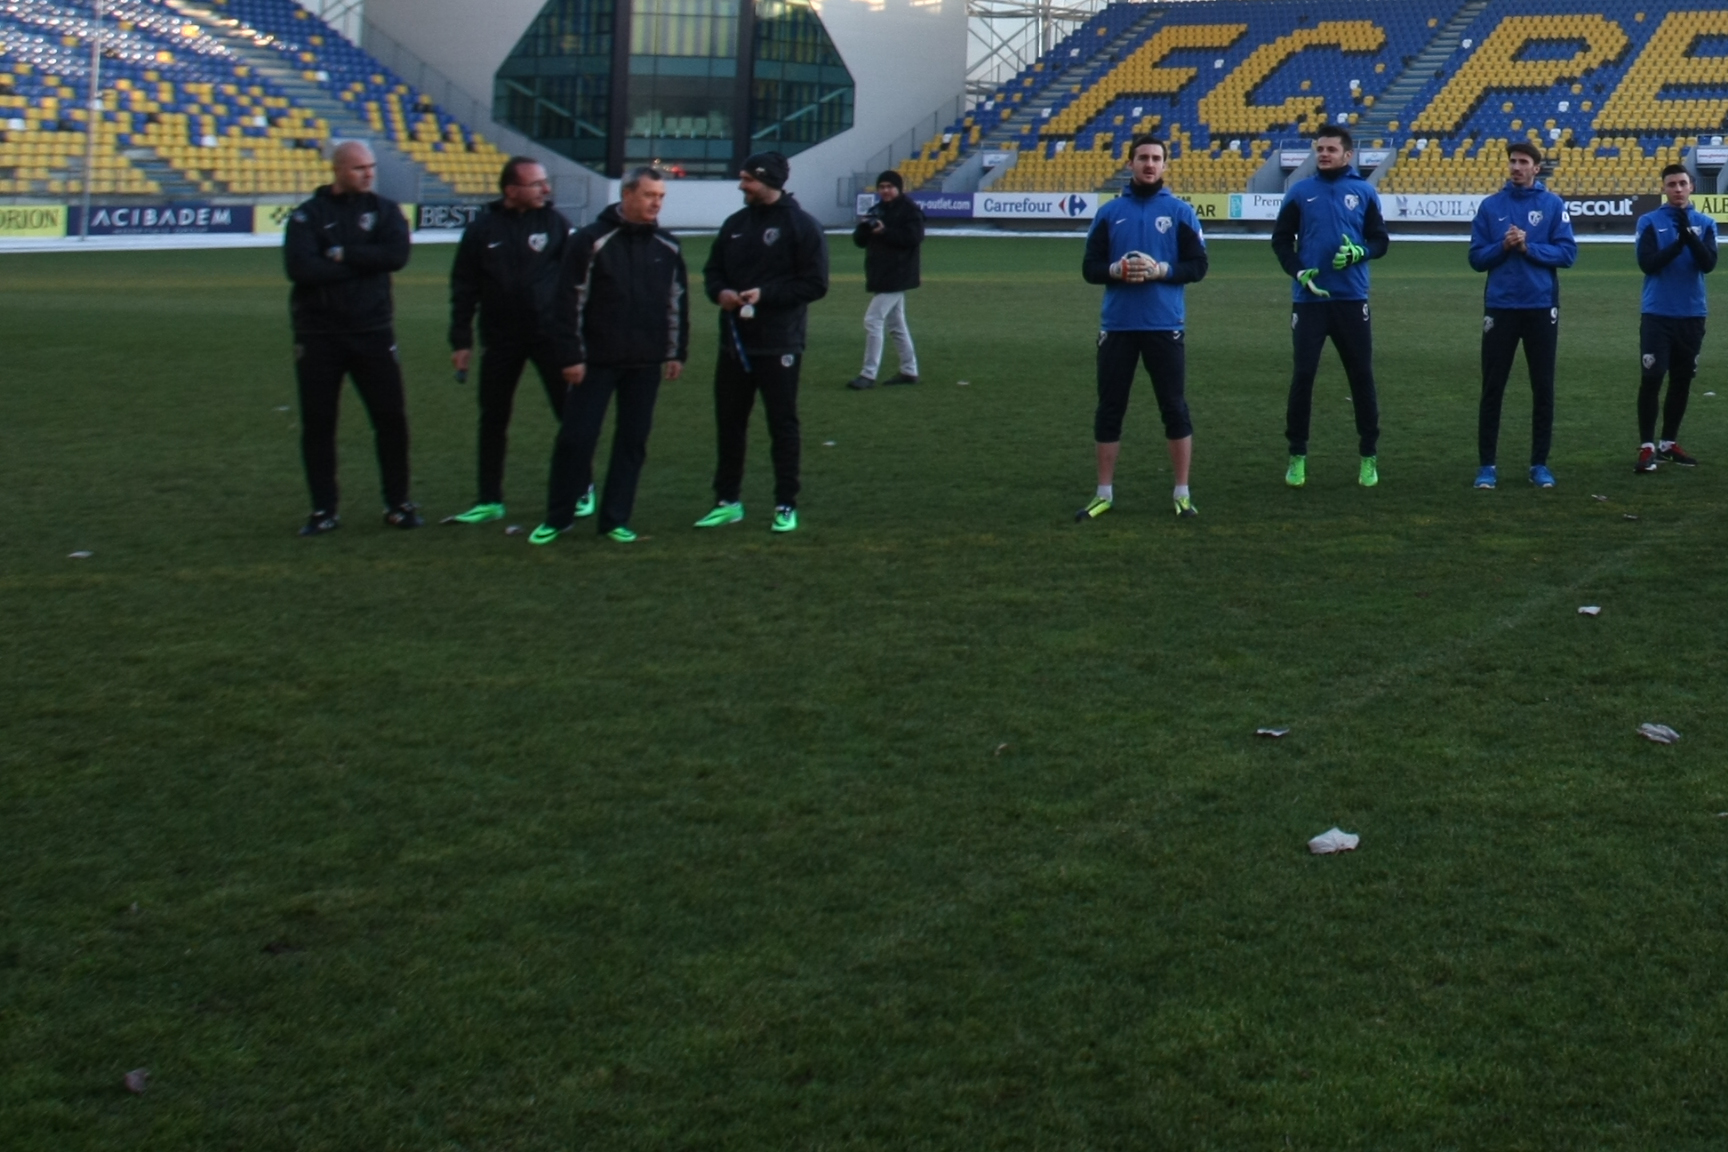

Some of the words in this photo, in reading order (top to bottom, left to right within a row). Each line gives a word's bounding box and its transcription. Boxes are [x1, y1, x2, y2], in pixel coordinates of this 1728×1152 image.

[1038, 20, 1387, 136] FC
[984, 197, 1053, 213] Carrefour
[1414, 200, 1477, 217] AQUILA
[91, 208, 232, 227] ACIBADEM
[420, 206, 481, 227] BEST
